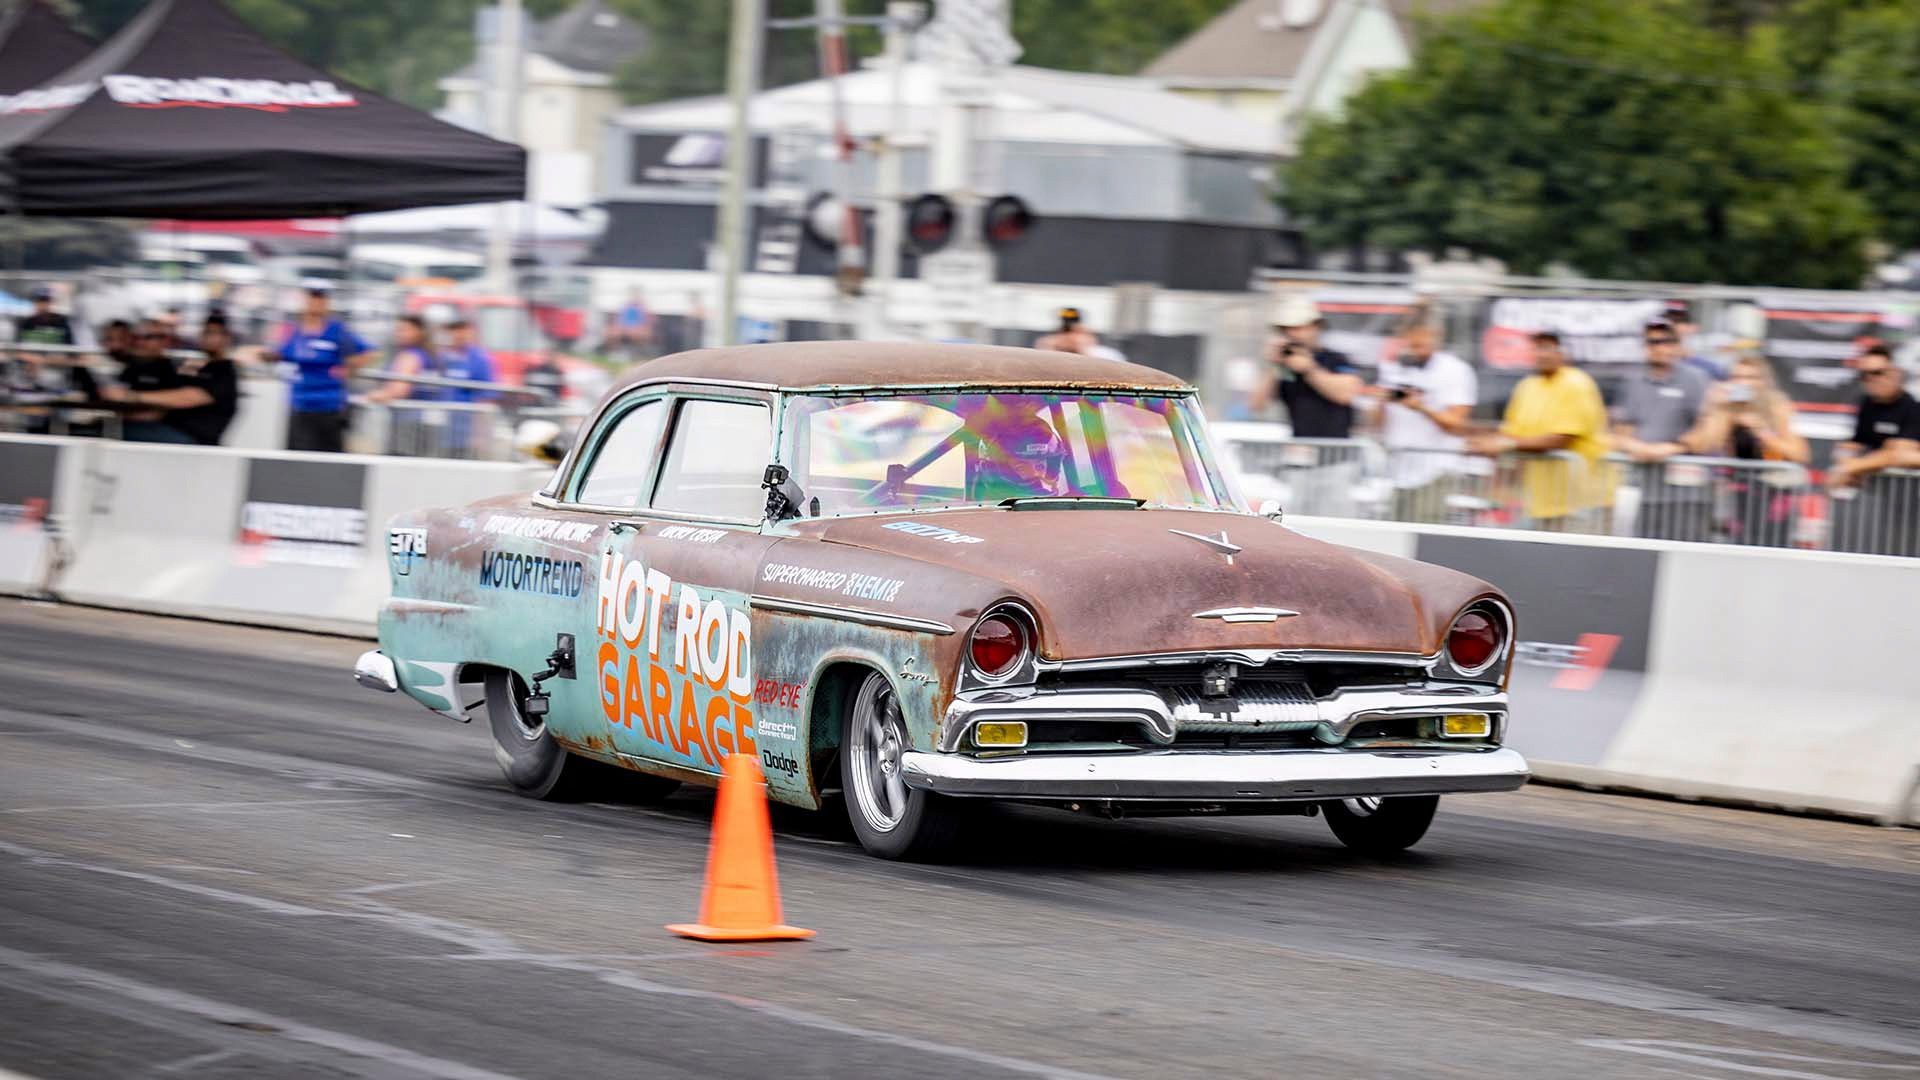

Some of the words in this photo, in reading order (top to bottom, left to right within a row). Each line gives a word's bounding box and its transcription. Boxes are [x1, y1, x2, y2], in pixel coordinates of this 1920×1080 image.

[480, 551, 584, 598] MOTORTREND
[762, 563, 848, 590] SUPERCHARGED
[598, 550, 672, 662] HOT
[675, 584, 752, 705] ROD
[598, 641, 757, 766] GARAGE
[762, 749, 799, 778] Dodge
